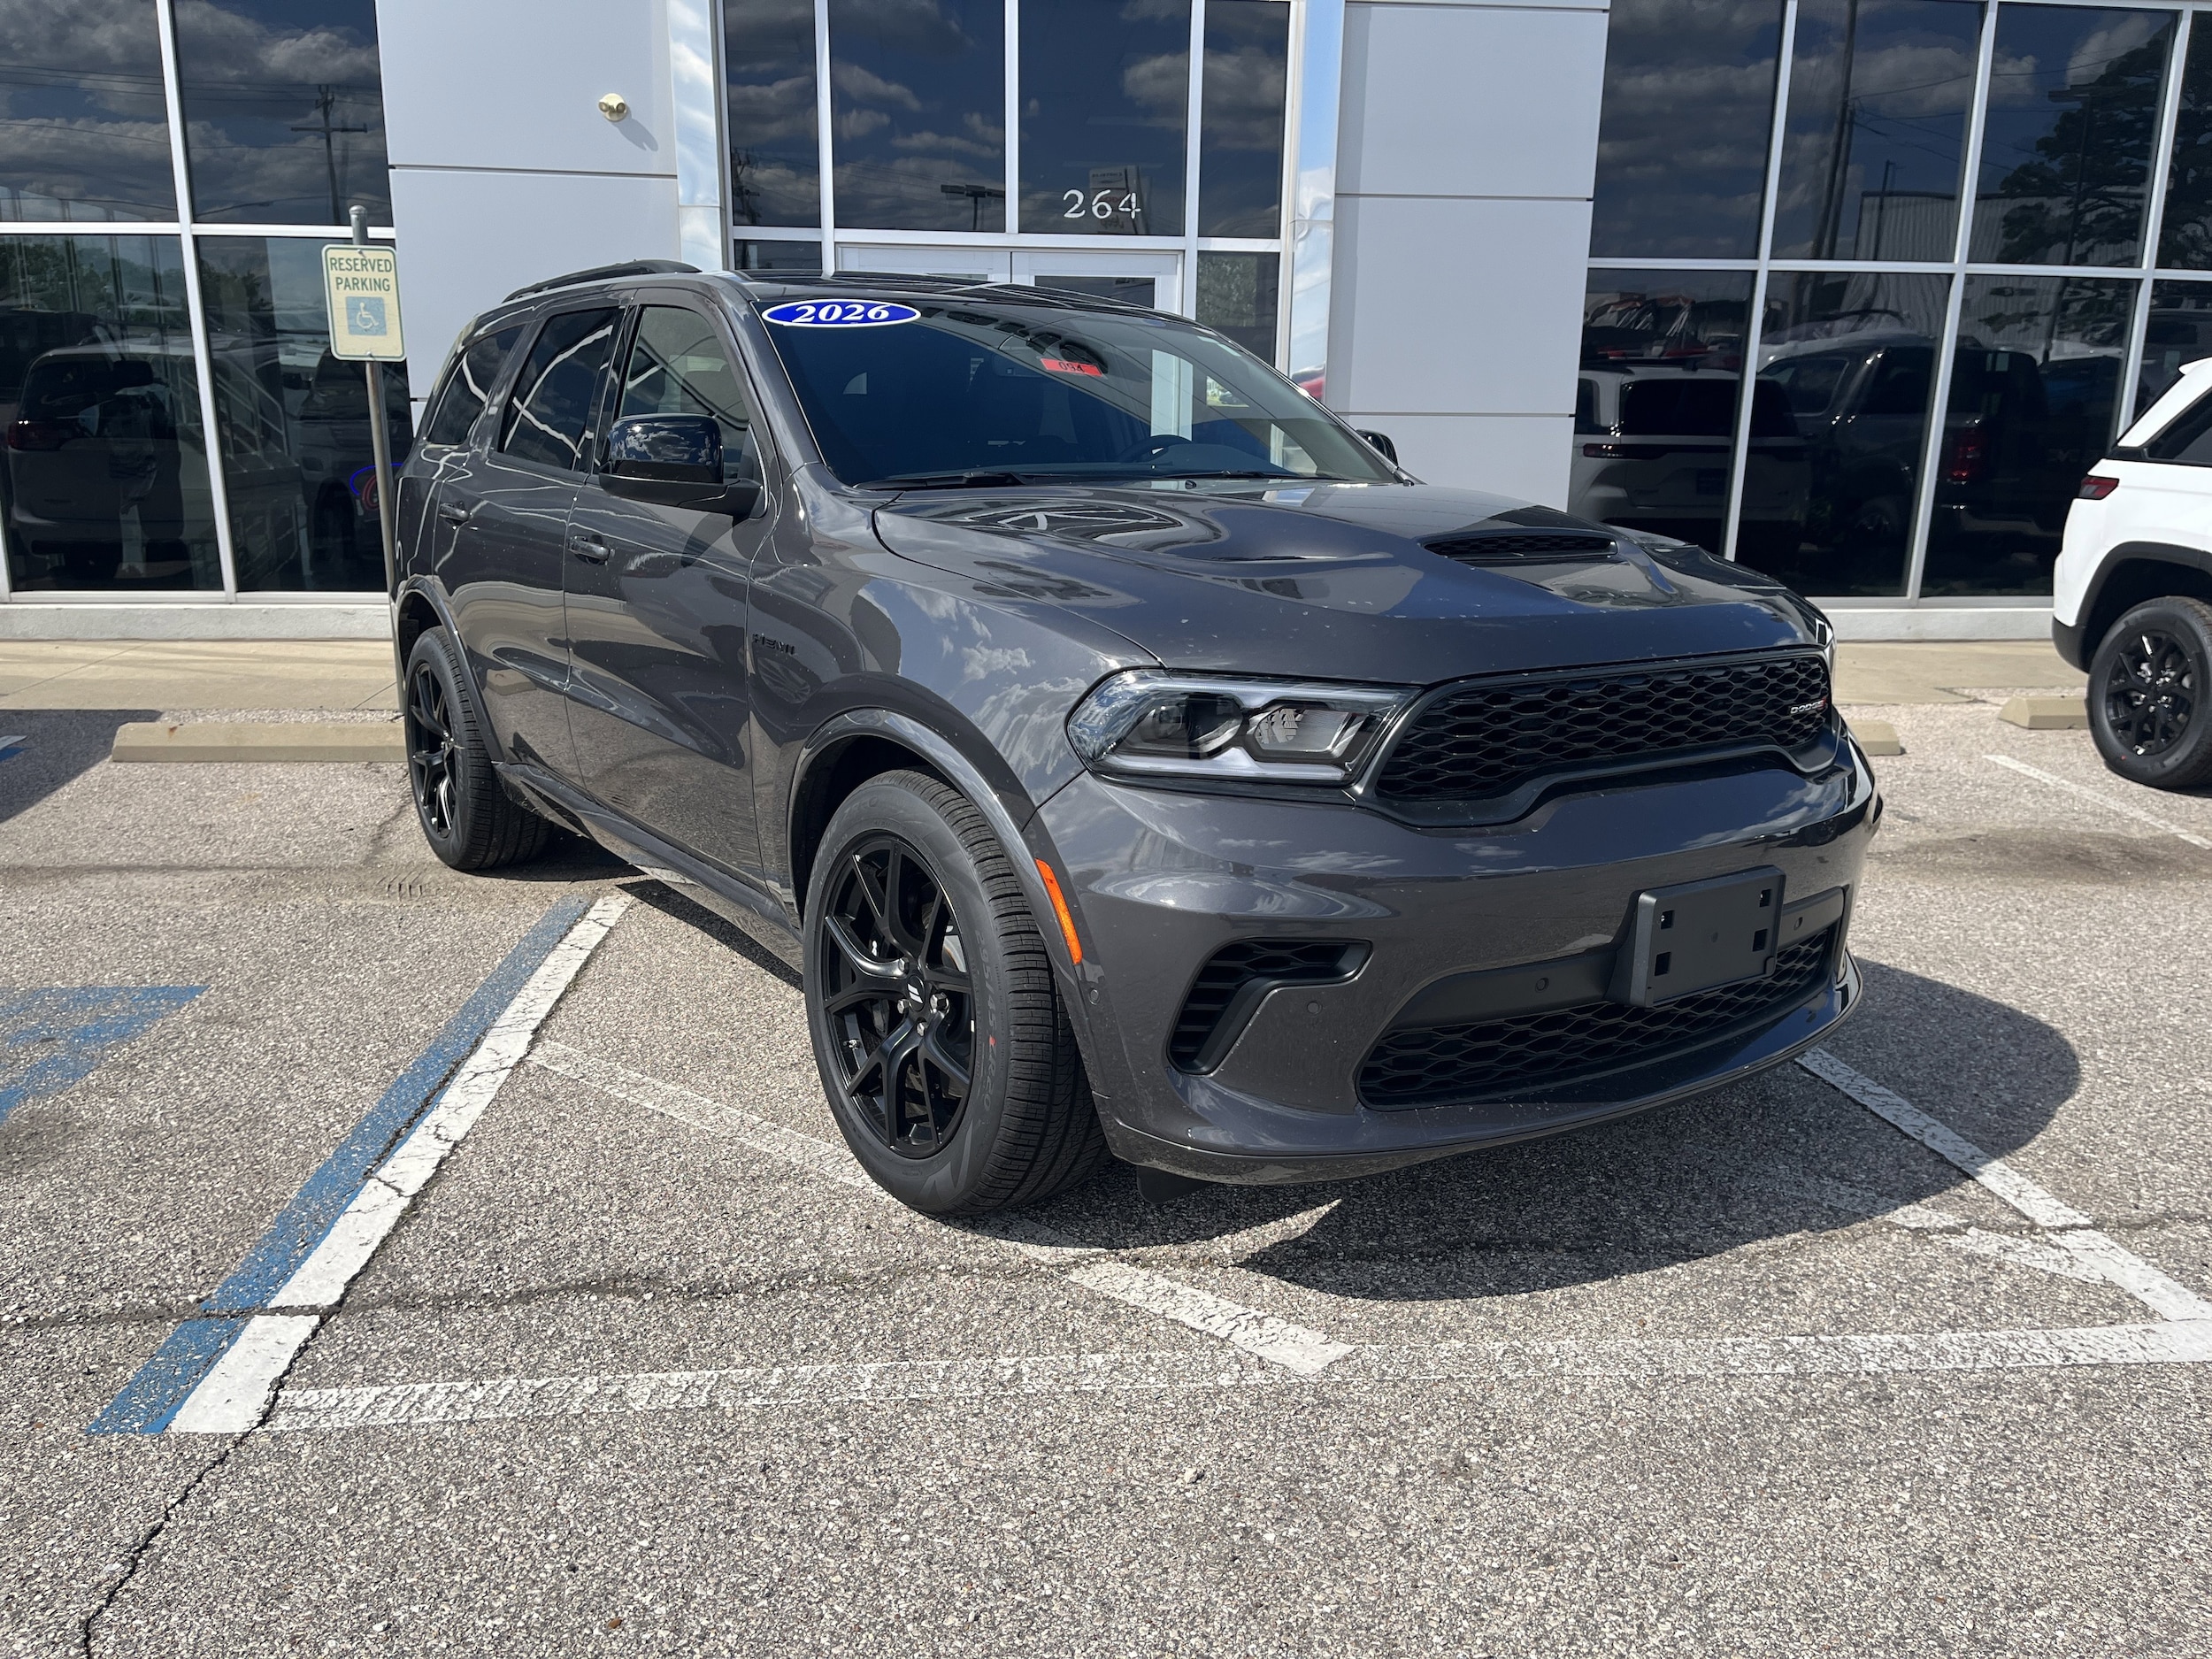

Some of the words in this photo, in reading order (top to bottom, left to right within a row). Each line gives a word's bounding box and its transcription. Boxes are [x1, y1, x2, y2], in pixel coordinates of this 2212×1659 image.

[1063, 188, 1141, 219] 264
[329, 257, 393, 273] RESERVED
[335, 277, 391, 292] PARKING
[792, 304, 891, 323] 2026
